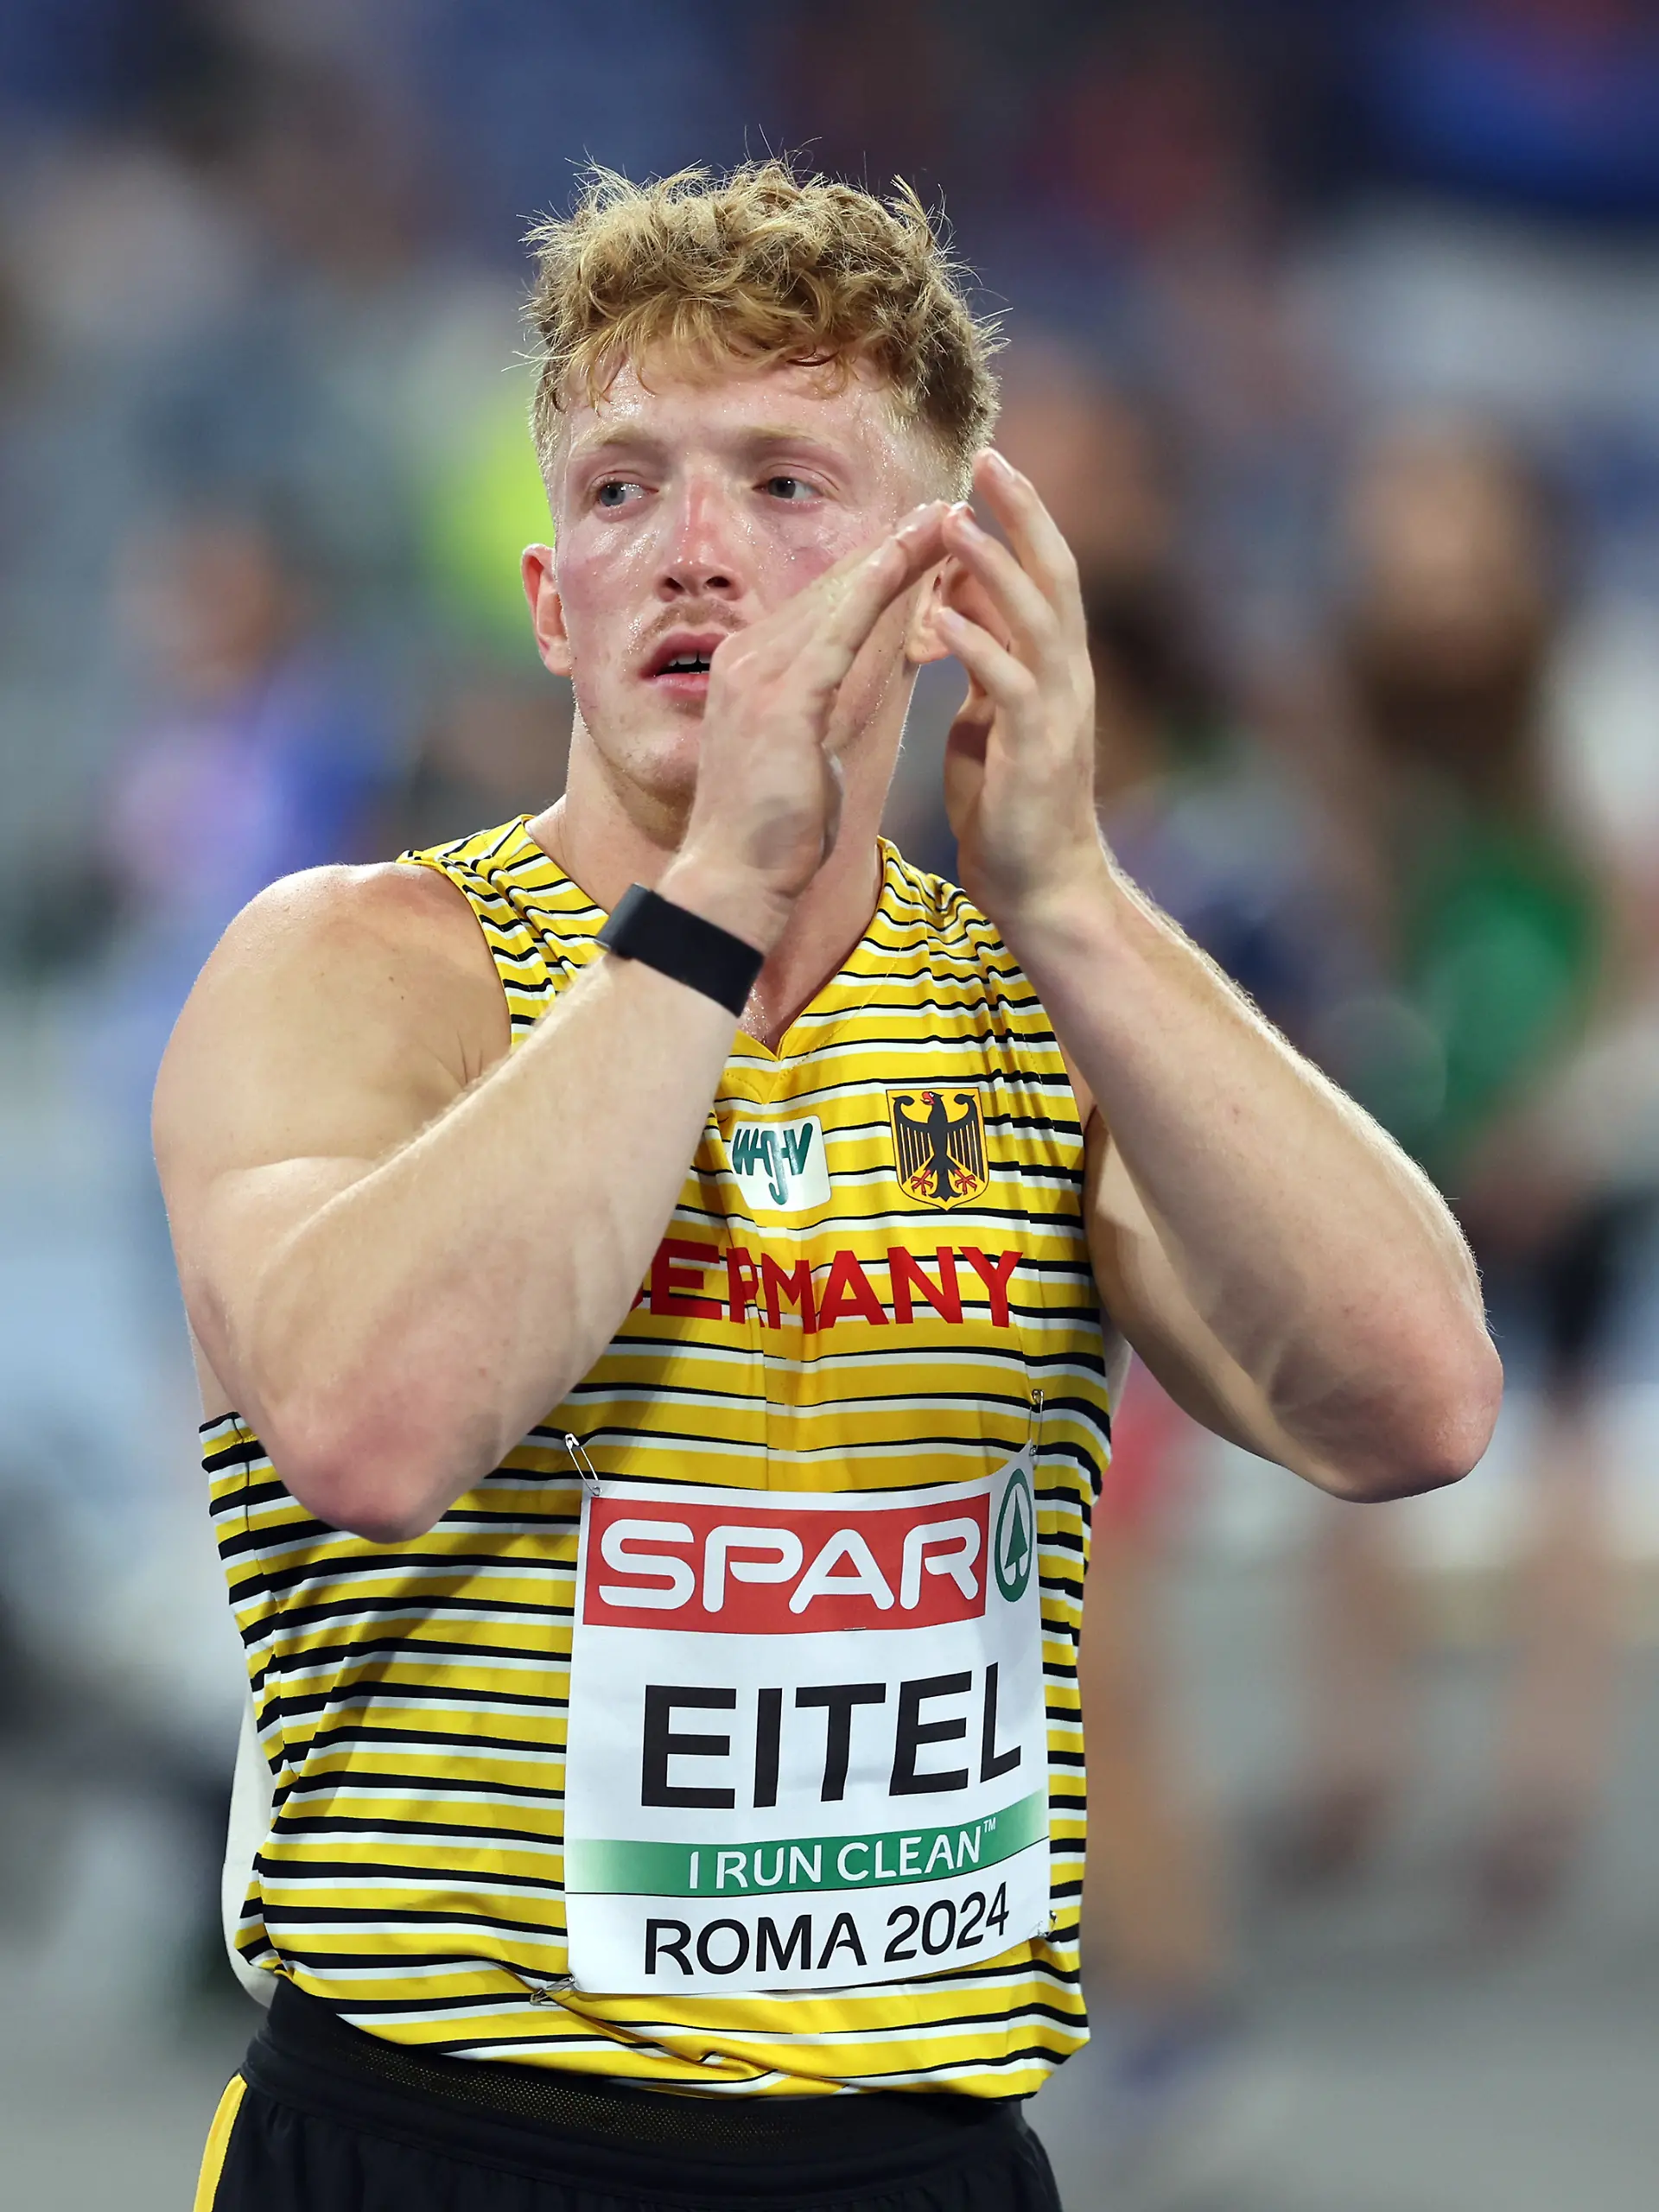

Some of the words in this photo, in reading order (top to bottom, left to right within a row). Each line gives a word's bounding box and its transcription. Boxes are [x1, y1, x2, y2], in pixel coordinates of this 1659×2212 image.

[632, 1237, 1024, 1335] ERMANY
[599, 1516, 982, 1614] SPAR
[640, 1662, 1022, 1809] EITEL
[689, 1851, 700, 1890] I
[715, 1844, 823, 1891] RUN
[645, 1912, 868, 1975] ROMA
[883, 1881, 1010, 1963] 2024
